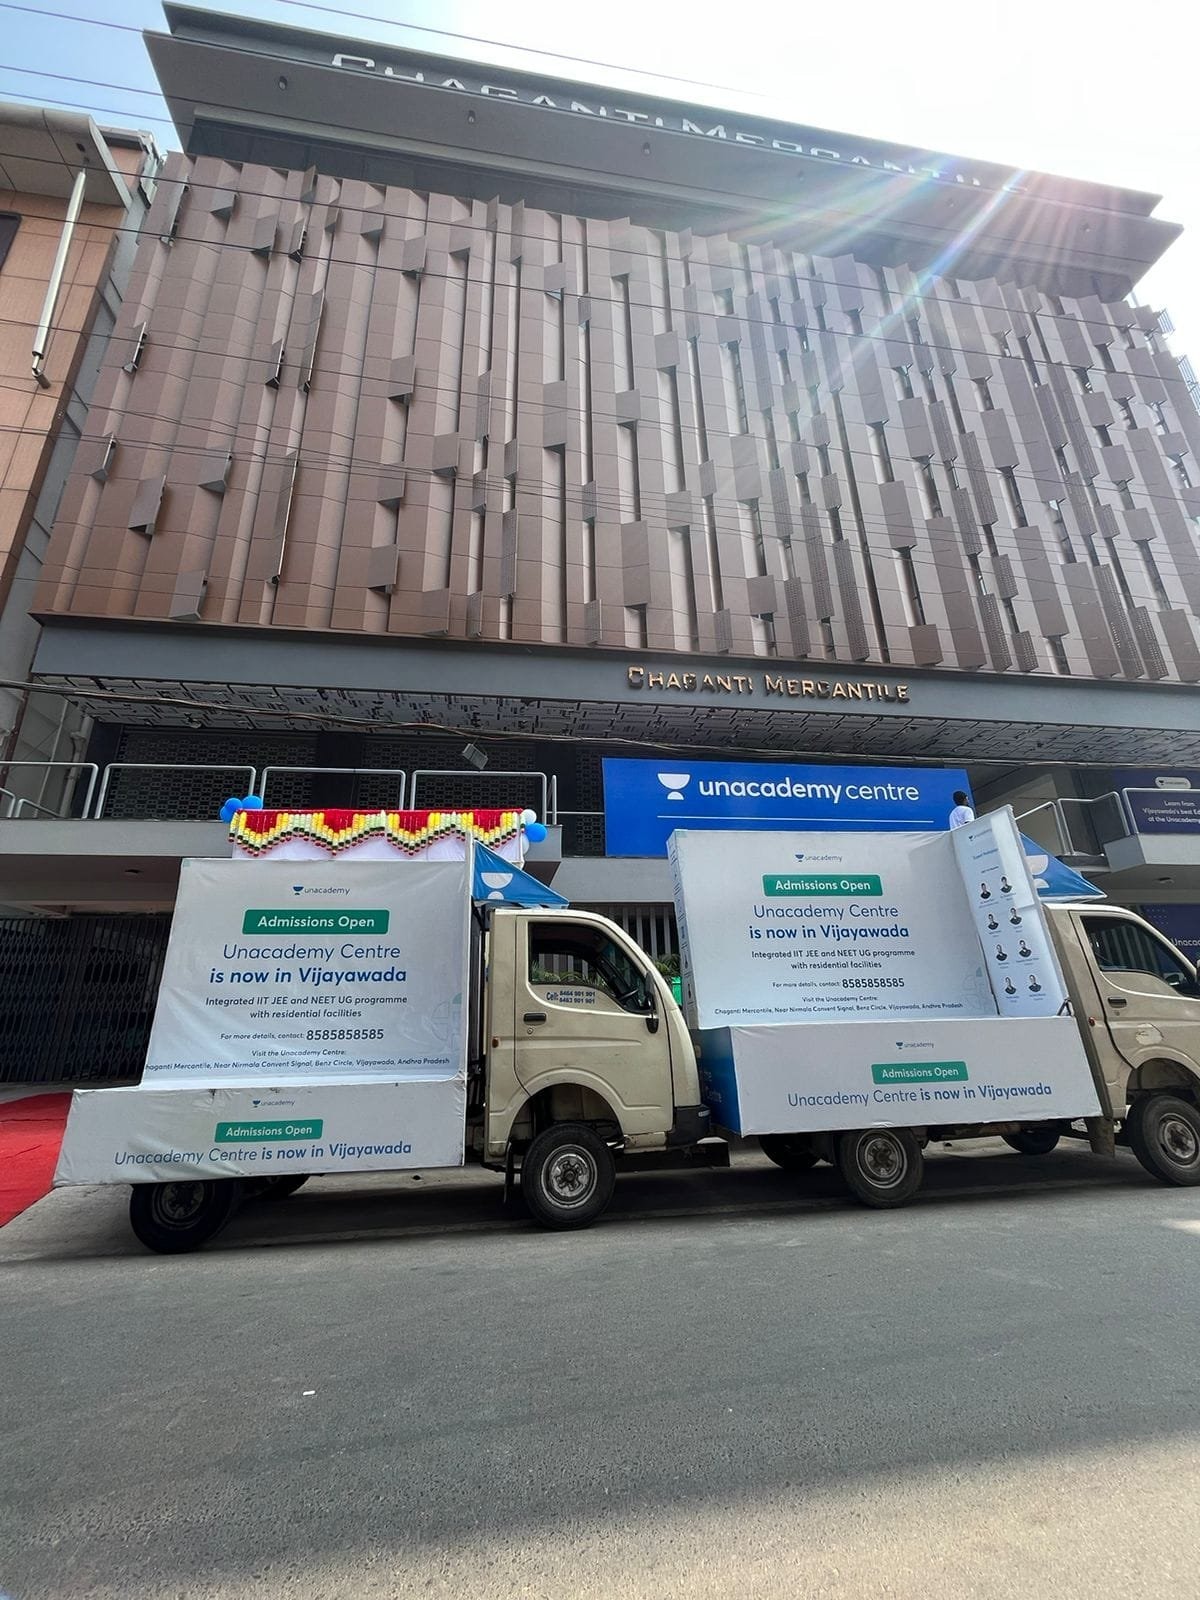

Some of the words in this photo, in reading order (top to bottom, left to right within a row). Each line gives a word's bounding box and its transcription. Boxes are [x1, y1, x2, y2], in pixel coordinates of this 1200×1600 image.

[764, 674, 910, 703] MERCANTILE
[699, 777, 842, 803] unacademy
[846, 782, 919, 800] centre
[805, 853, 843, 862] unacademy
[304, 886, 350, 895] unacademy
[775, 879, 838, 891] Admissions
[840, 879, 871, 893] Open
[753, 903, 844, 920] Unacademy
[849, 903, 899, 918] Centre
[257, 915, 334, 928] Admissions
[338, 915, 375, 930] Open
[749, 925, 762, 939] is
[766, 928, 797, 939] now
[801, 925, 816, 939] in
[820, 924, 909, 942] Vijayawada
[1170, 937, 1200, 946] Unaca
[223, 943, 335, 962] Unacademy
[340, 943, 401, 959] Centre
[751, 949, 792, 960] Integrated
[793, 950, 803, 958] IIT
[805, 950, 819, 958] JEE
[821, 949, 836, 957] and
[837, 949, 857, 957] NEET
[859, 949, 871, 957] UG
[873, 950, 915, 960] programme
[791, 961, 808, 970] with
[809, 960, 849, 969] residential
[850, 960, 882, 969] facilities
[210, 967, 224, 983] is
[230, 971, 268, 983] now
[275, 967, 292, 982] in
[298, 965, 407, 987] Vijayawada
[842, 978, 905, 989] 8585858585
[205, 997, 253, 1008] Integrated
[256, 996, 269, 1005] IIT
[271, 996, 288, 1005] JEE
[290, 996, 308, 1005] and
[310, 995, 336, 1005] NEET
[338, 995, 352, 1004] UG
[354, 996, 408, 1007] programme
[250, 1009, 269, 1019] with
[271, 1009, 321, 1018] residential
[323, 1008, 362, 1018] facilities
[306, 1028, 384, 1041] 8585858585
[268, 1049, 279, 1057] the
[280, 1049, 320, 1058] Unacademy
[145, 1063, 172, 1072] haganti
[214, 1061, 230, 1069] Near
[231, 1061, 260, 1069] Nirmala
[261, 1060, 289, 1068] Convent
[315, 1059, 331, 1067] Benz
[423, 1057, 450, 1065] Pradesh
[882, 1068, 933, 1080] Admissions
[935, 1067, 959, 1080] Open
[788, 1089, 868, 1107] Unacademy
[873, 1087, 917, 1103] Centre
[920, 1086, 931, 1101] is
[934, 1089, 960, 1101] now
[964, 1084, 976, 1099] in
[978, 1082, 1052, 1101] Vijayawada
[261, 1099, 295, 1108] unacademy
[225, 1124, 282, 1138] Admissions
[285, 1123, 312, 1138] Open
[114, 1147, 204, 1166] Unacademy
[209, 1146, 257, 1163] Centre
[261, 1145, 272, 1160] is
[276, 1148, 307, 1160] now
[311, 1144, 324, 1158] in
[329, 1140, 412, 1160] Vijayawada
